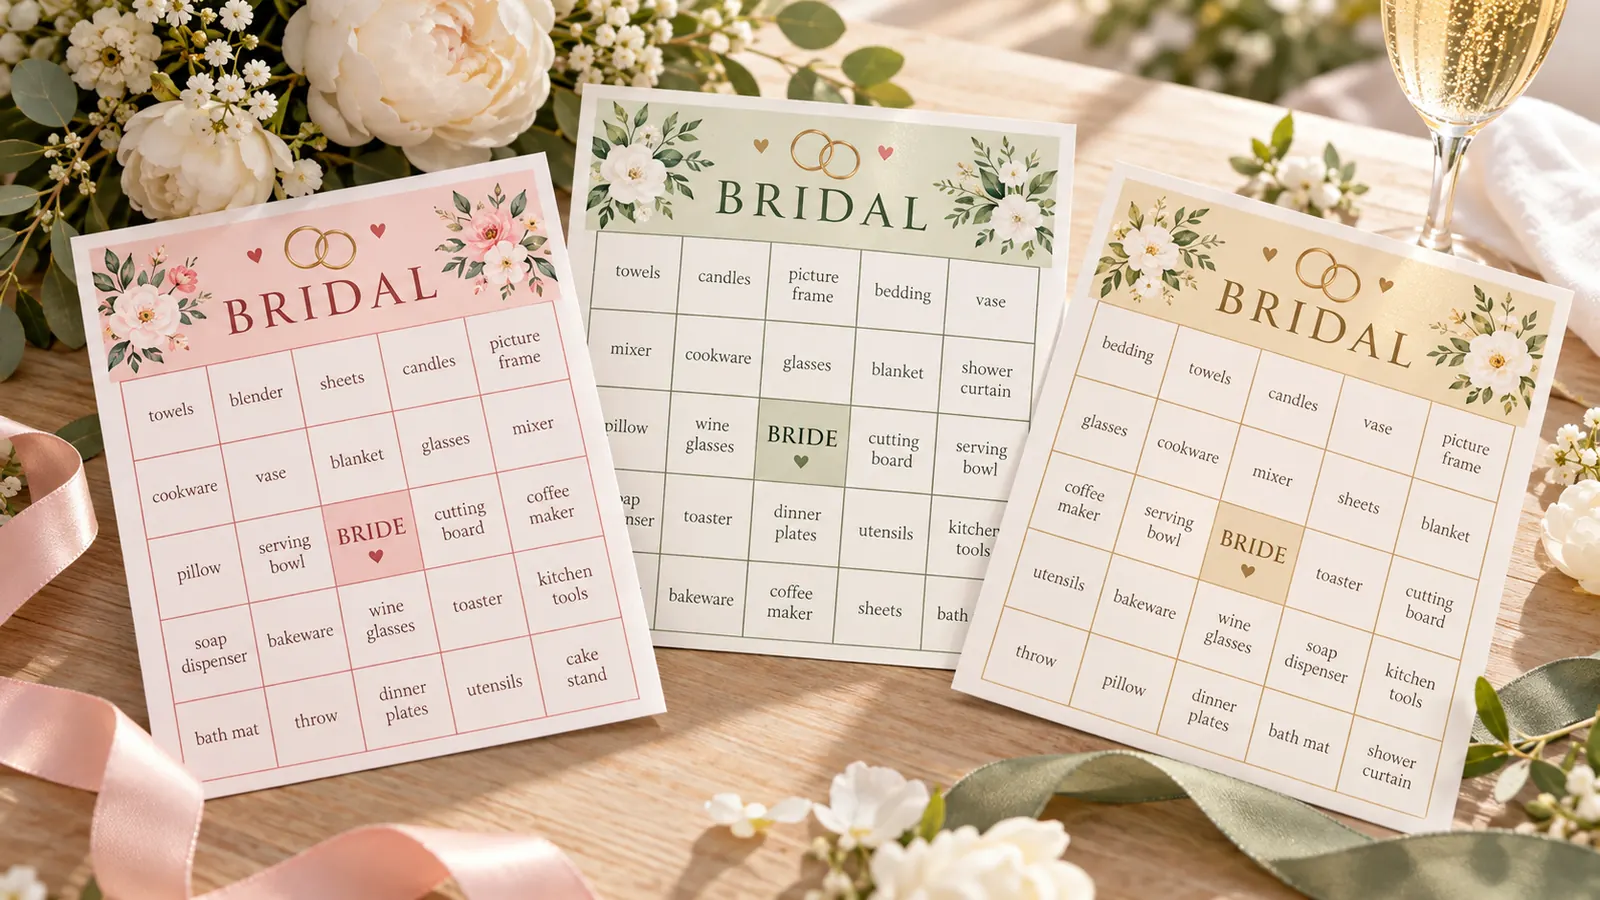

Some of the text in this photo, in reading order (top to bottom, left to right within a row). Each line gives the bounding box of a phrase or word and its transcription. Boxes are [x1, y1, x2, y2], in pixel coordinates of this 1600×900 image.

[715, 179, 927, 231] BRIDAL
[615, 264, 660, 279] towels
[697, 270, 750, 285] candles
[788, 267, 839, 283] picture
[223, 266, 438, 335] BRIDAL
[792, 285, 833, 303] frame
[874, 282, 931, 305] bedding
[975, 296, 1006, 308] vase
[1216, 278, 1412, 370] BRIDAL
[489, 332, 540, 354] picture
[610, 341, 651, 356] mixer
[1101, 335, 1154, 365] bedding
[402, 355, 456, 375] candles
[498, 352, 541, 369] frame
[684, 347, 751, 364] cookware
[782, 354, 831, 372] glasses
[871, 361, 923, 379] blanket
[961, 360, 1013, 377] shower
[1188, 362, 1231, 384] towels
[319, 373, 365, 390] sheets
[960, 383, 1010, 398] curtain
[228, 386, 283, 406] blender
[1268, 389, 1318, 411] candles
[148, 401, 194, 422] towels
[512, 418, 553, 435] mixer
[604, 418, 648, 434] pillow
[695, 417, 729, 432] wine
[1080, 413, 1128, 436] glasses
[1363, 418, 1392, 435] vase
[421, 434, 470, 456] glasses
[685, 435, 734, 454] glasses
[767, 424, 837, 447] BRIDE
[868, 432, 919, 454] cutting
[955, 441, 1007, 462] serving
[1157, 438, 1219, 464] cookware
[1441, 433, 1489, 460] picture
[329, 448, 384, 469] blanket
[871, 450, 912, 468] board
[963, 459, 997, 476] bowl
[1441, 448, 1483, 474] frame
[255, 469, 286, 482] vase
[1252, 467, 1293, 487] mixer
[152, 482, 217, 503] cookware
[526, 484, 569, 503] coffee
[1062, 483, 1104, 504] coffee
[1337, 491, 1379, 514] sheets
[434, 502, 486, 525] cutting
[529, 506, 574, 524] maker
[684, 511, 732, 525] toaster
[773, 503, 821, 520] dinner
[1057, 497, 1102, 521] maker
[1144, 506, 1194, 533] serving
[336, 516, 406, 545] BRIDE
[441, 519, 484, 540] board
[774, 524, 816, 543] plates
[858, 525, 913, 540] utensils
[1146, 522, 1183, 546] bowl
[1420, 515, 1470, 543] blanket
[258, 535, 311, 558] serving
[956, 542, 990, 557] tools
[1219, 528, 1287, 566] BRIDE
[177, 562, 220, 585] pillow
[268, 553, 305, 573] bowl
[536, 566, 592, 589] kitchen
[1033, 568, 1084, 591] utensils
[1315, 568, 1363, 591] toaster
[551, 586, 588, 605] tools
[668, 587, 734, 606] bakeware
[769, 584, 812, 600] coffee
[1405, 587, 1453, 614] cutting
[368, 601, 403, 617] wine
[452, 594, 502, 612] toaster
[767, 604, 813, 620] maker
[857, 600, 902, 617] sheets
[937, 605, 968, 622] bath
[1113, 588, 1176, 619] bakeware
[1218, 613, 1250, 631] wine
[1405, 603, 1448, 628] board
[194, 635, 227, 650] soap
[266, 626, 333, 647] bakeware
[366, 621, 415, 643] glasses
[1203, 627, 1252, 653] glasses
[181, 651, 247, 674] dispenser
[566, 648, 598, 665] cake
[1015, 644, 1057, 667] throw
[1305, 642, 1337, 662] soap
[567, 665, 607, 687] stand
[1284, 652, 1348, 683] dispenser
[1385, 662, 1435, 692] kitchen
[379, 683, 426, 701] dinner
[466, 673, 523, 696] utensils
[1101, 674, 1146, 696] pillow
[1189, 688, 1237, 715] dinner
[1389, 688, 1422, 708] tools
[294, 711, 337, 728] throw
[385, 704, 428, 726] plates
[1187, 709, 1229, 731] plates
[194, 723, 259, 746] bath mat
[1268, 722, 1329, 754] bath mat
[1366, 744, 1416, 772] shower
[1362, 761, 1413, 789] curtain
